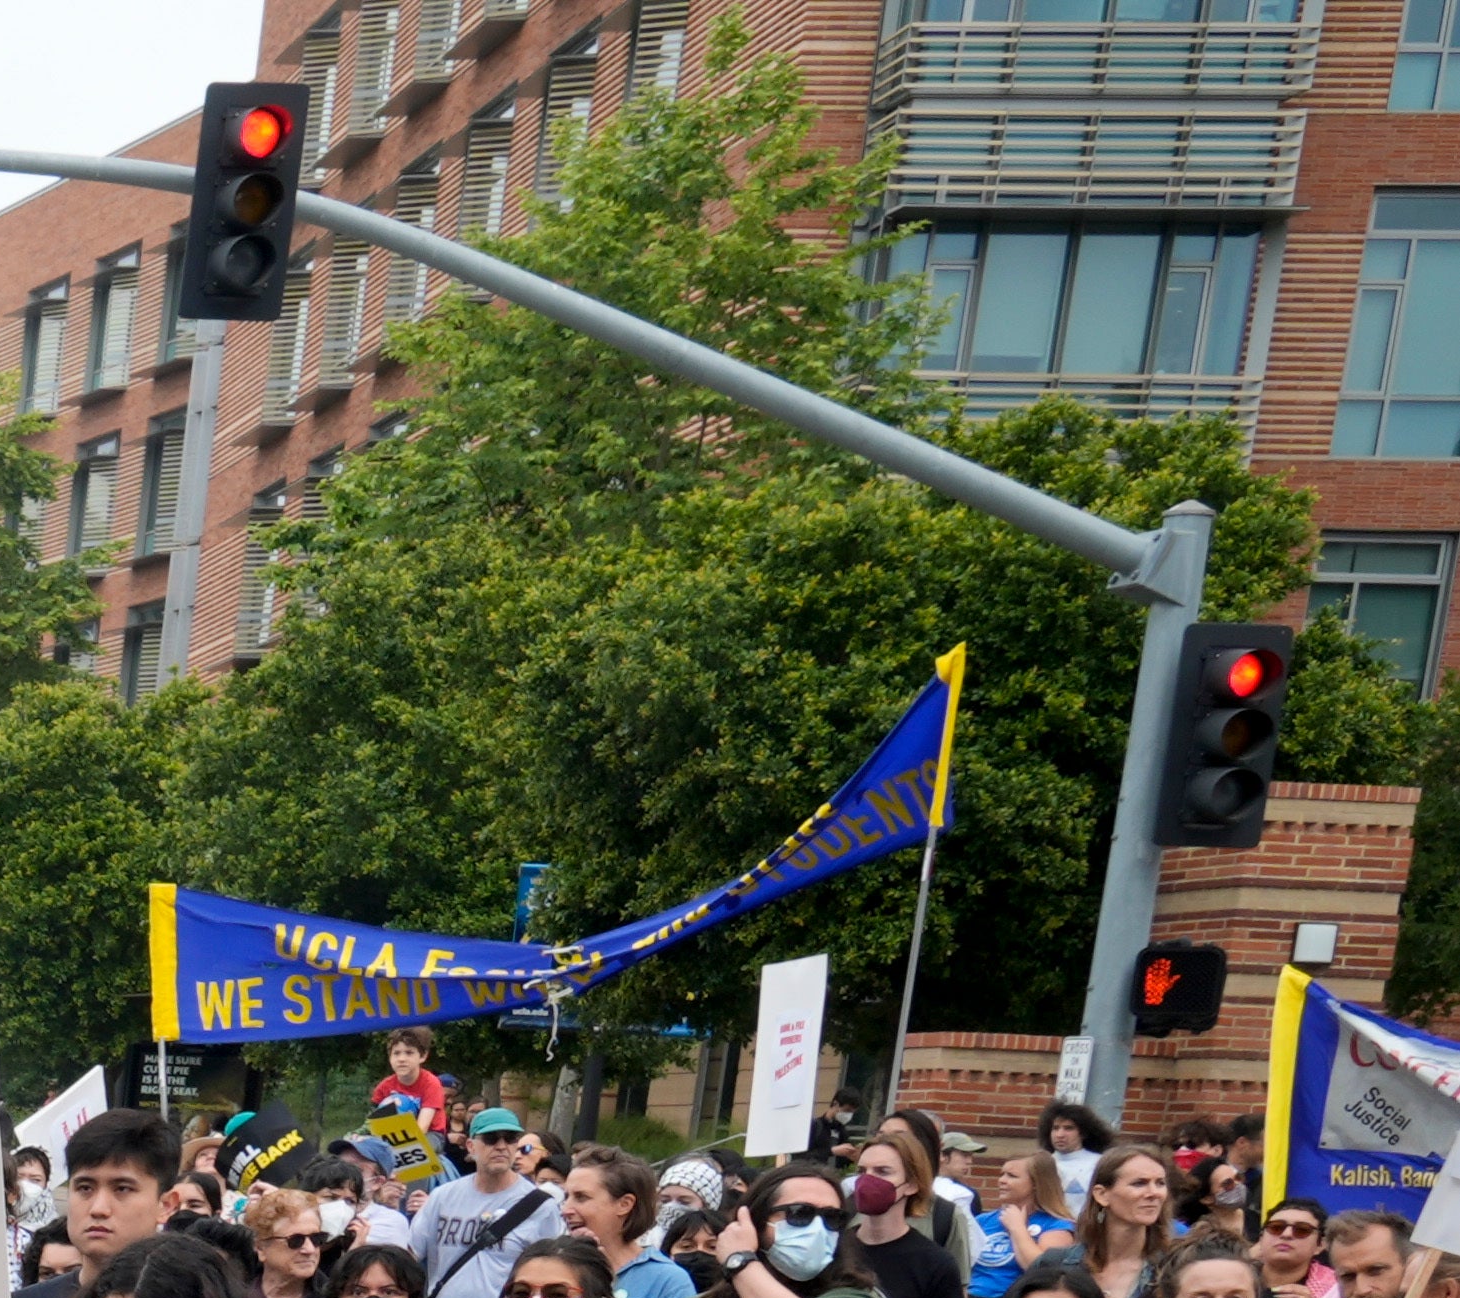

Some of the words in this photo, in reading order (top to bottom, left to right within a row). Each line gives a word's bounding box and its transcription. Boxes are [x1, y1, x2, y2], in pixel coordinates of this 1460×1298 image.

[274, 923, 398, 978] UCLA
[197, 977, 264, 1031] WE
[282, 974, 441, 1024] STAND
[1065, 1043, 1089, 1054] CROSS
[143, 1065, 172, 1074] CUE
[174, 1067, 190, 1075] PIE
[144, 1055, 175, 1064] MAE
[176, 1056, 203, 1066] SURE
[142, 1075, 151, 1083] IS
[167, 1076, 186, 1085] THE
[173, 1087, 199, 1097] SEAT.
[1363, 1086, 1412, 1131] Social
[1344, 1100, 1400, 1146] Justice
[255, 1128, 304, 1169] BACK
[381, 1130, 417, 1147] ALL
[1330, 1164, 1396, 1188] Kalish,
